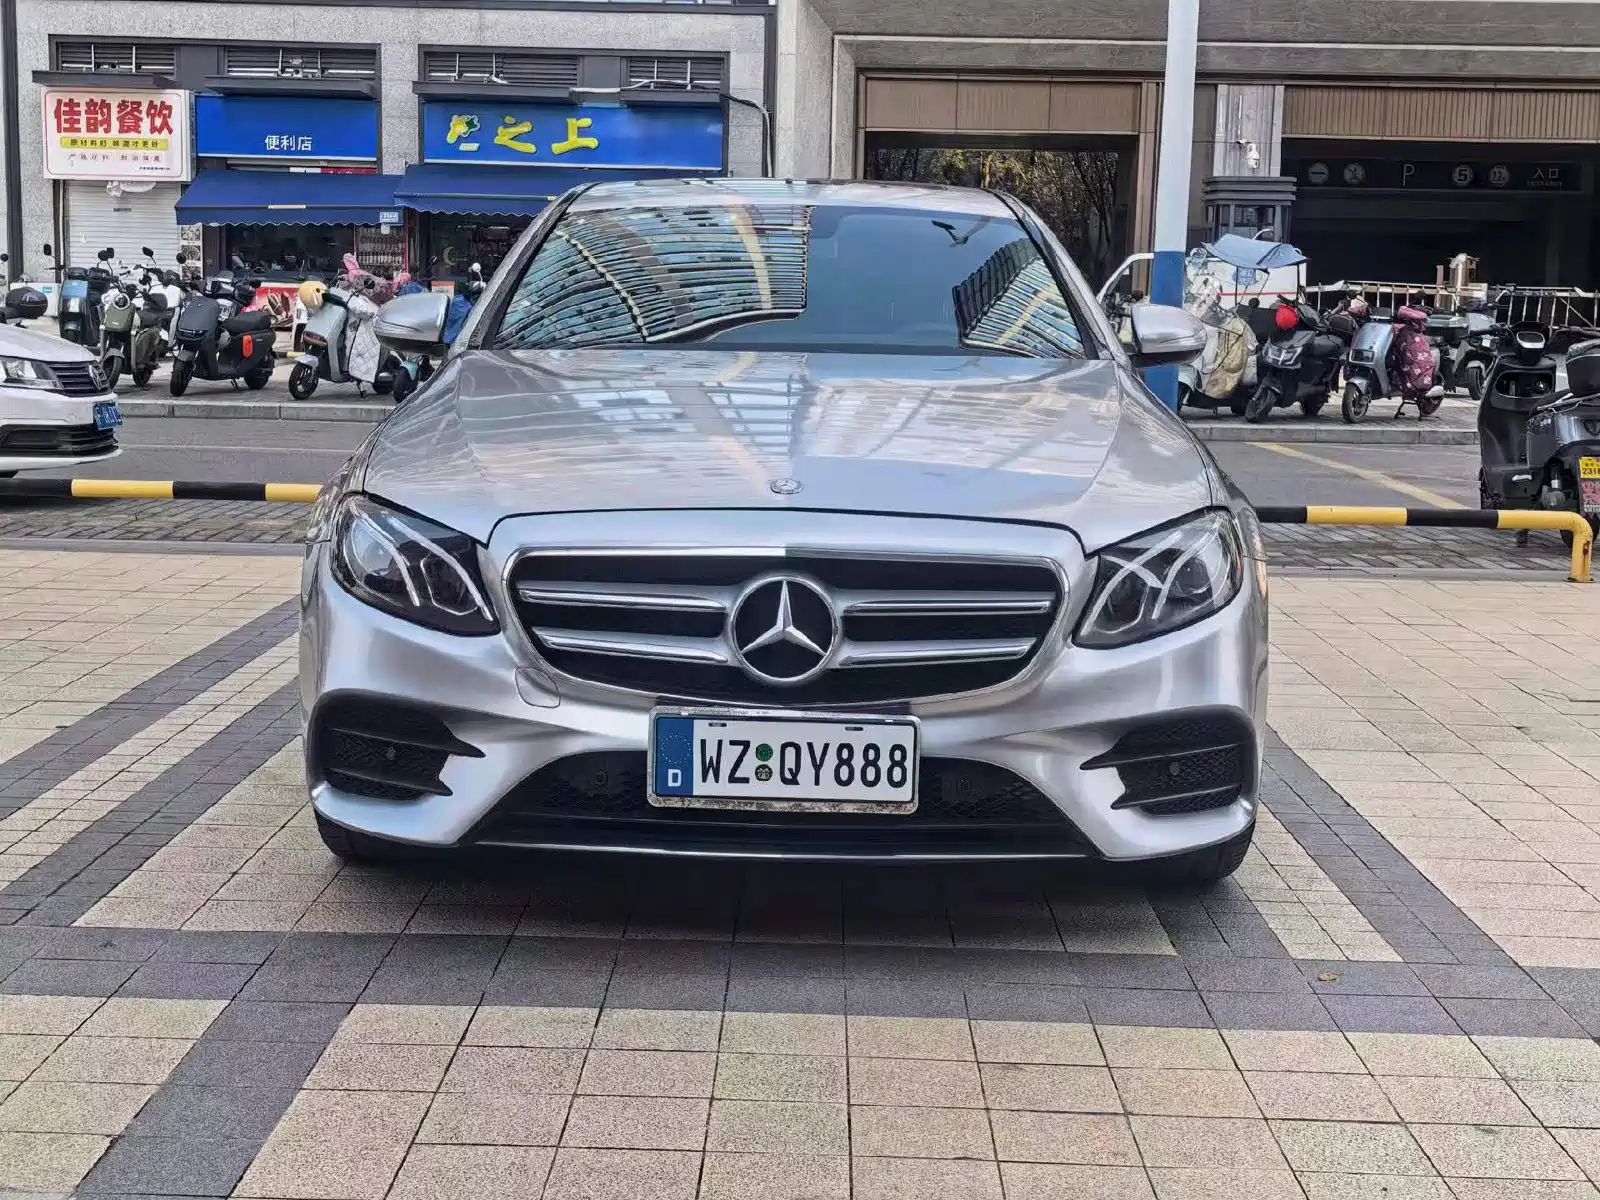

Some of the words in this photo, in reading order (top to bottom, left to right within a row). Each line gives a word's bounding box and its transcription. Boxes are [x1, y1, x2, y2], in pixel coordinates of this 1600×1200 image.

[54, 97, 174, 135] 佳韵餐饮
[264, 134, 313, 151] 便利店
[1402, 164, 1415, 186] P
[1532, 167, 1560, 180] 入口
[700, 738, 751, 784] WZ
[779, 741, 908, 789] QY888
[667, 768, 682, 787] D
